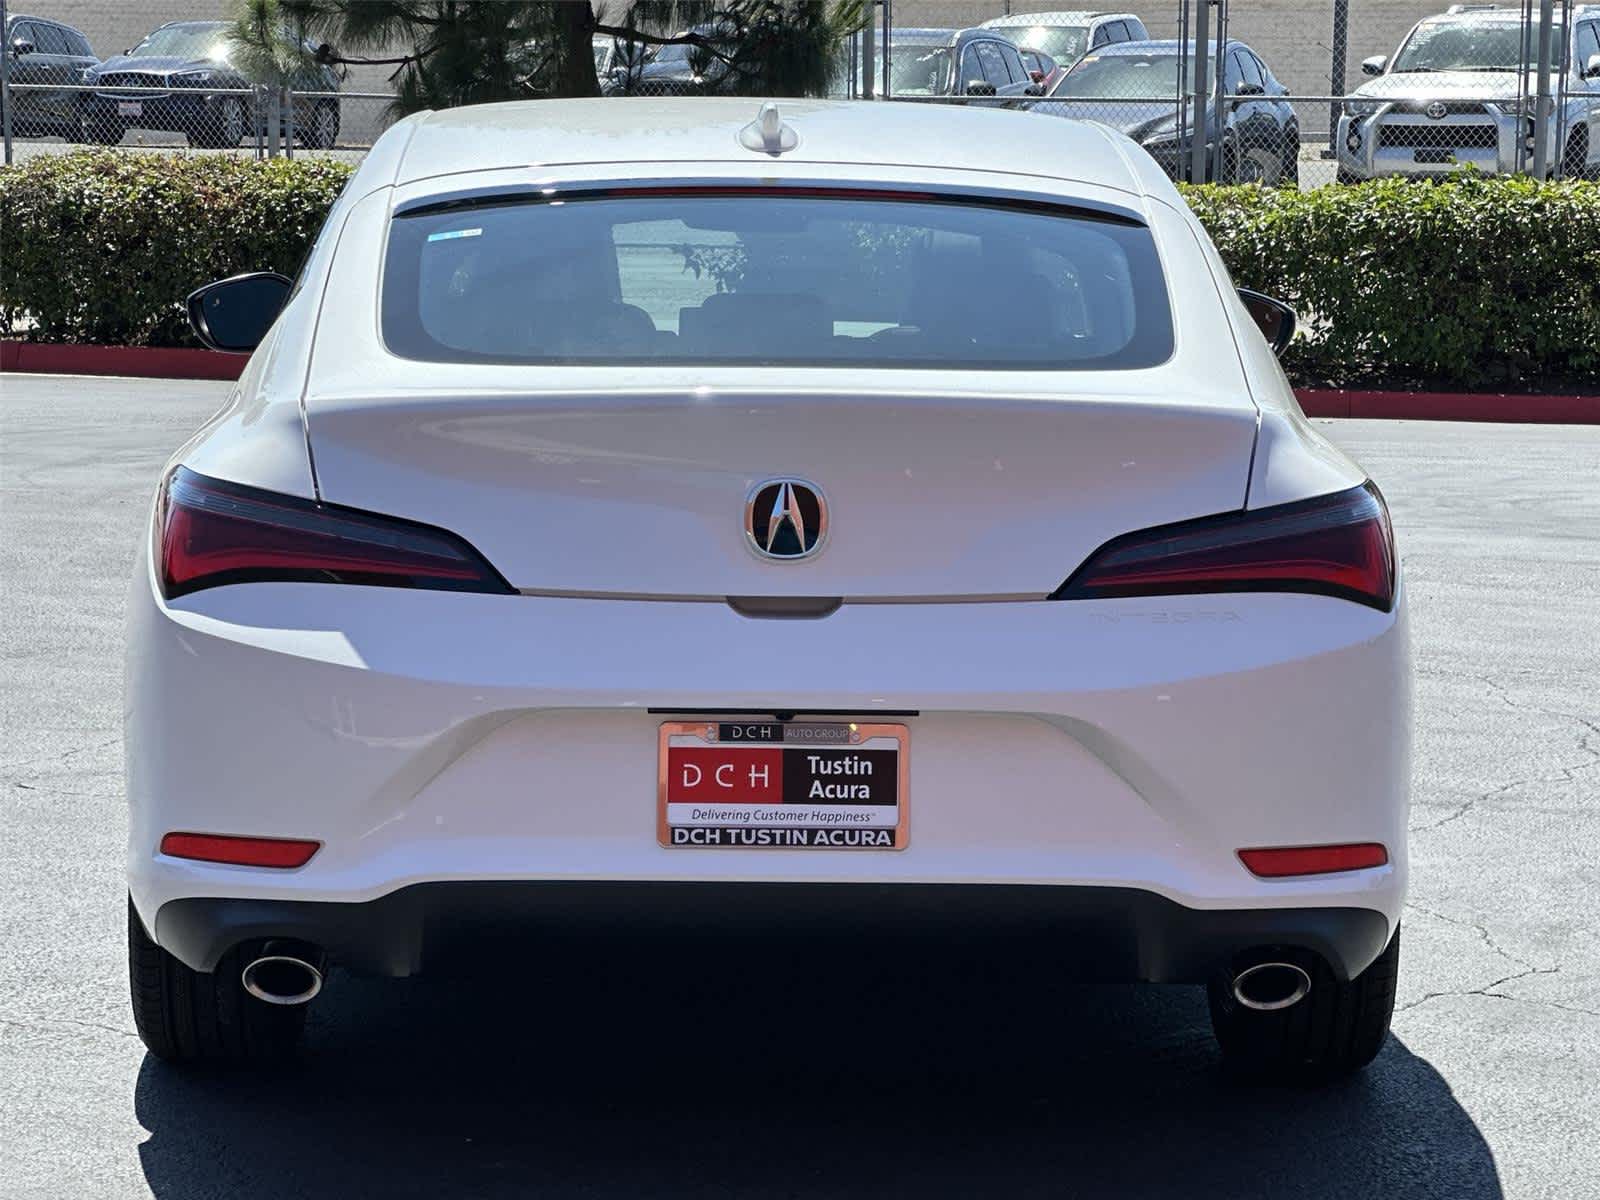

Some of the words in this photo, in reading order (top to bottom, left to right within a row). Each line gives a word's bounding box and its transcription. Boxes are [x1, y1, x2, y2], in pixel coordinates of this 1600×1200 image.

[786, 727, 813, 738] AUTO
[815, 728, 848, 739] GROUP
[807, 756, 873, 775] Tustin
[809, 780, 870, 799] Acura
[692, 808, 750, 822] Delivering
[753, 809, 808, 821] Customer
[674, 829, 720, 844] DCH
[726, 829, 808, 845] TUSTIN
[814, 830, 892, 846] ACURA
